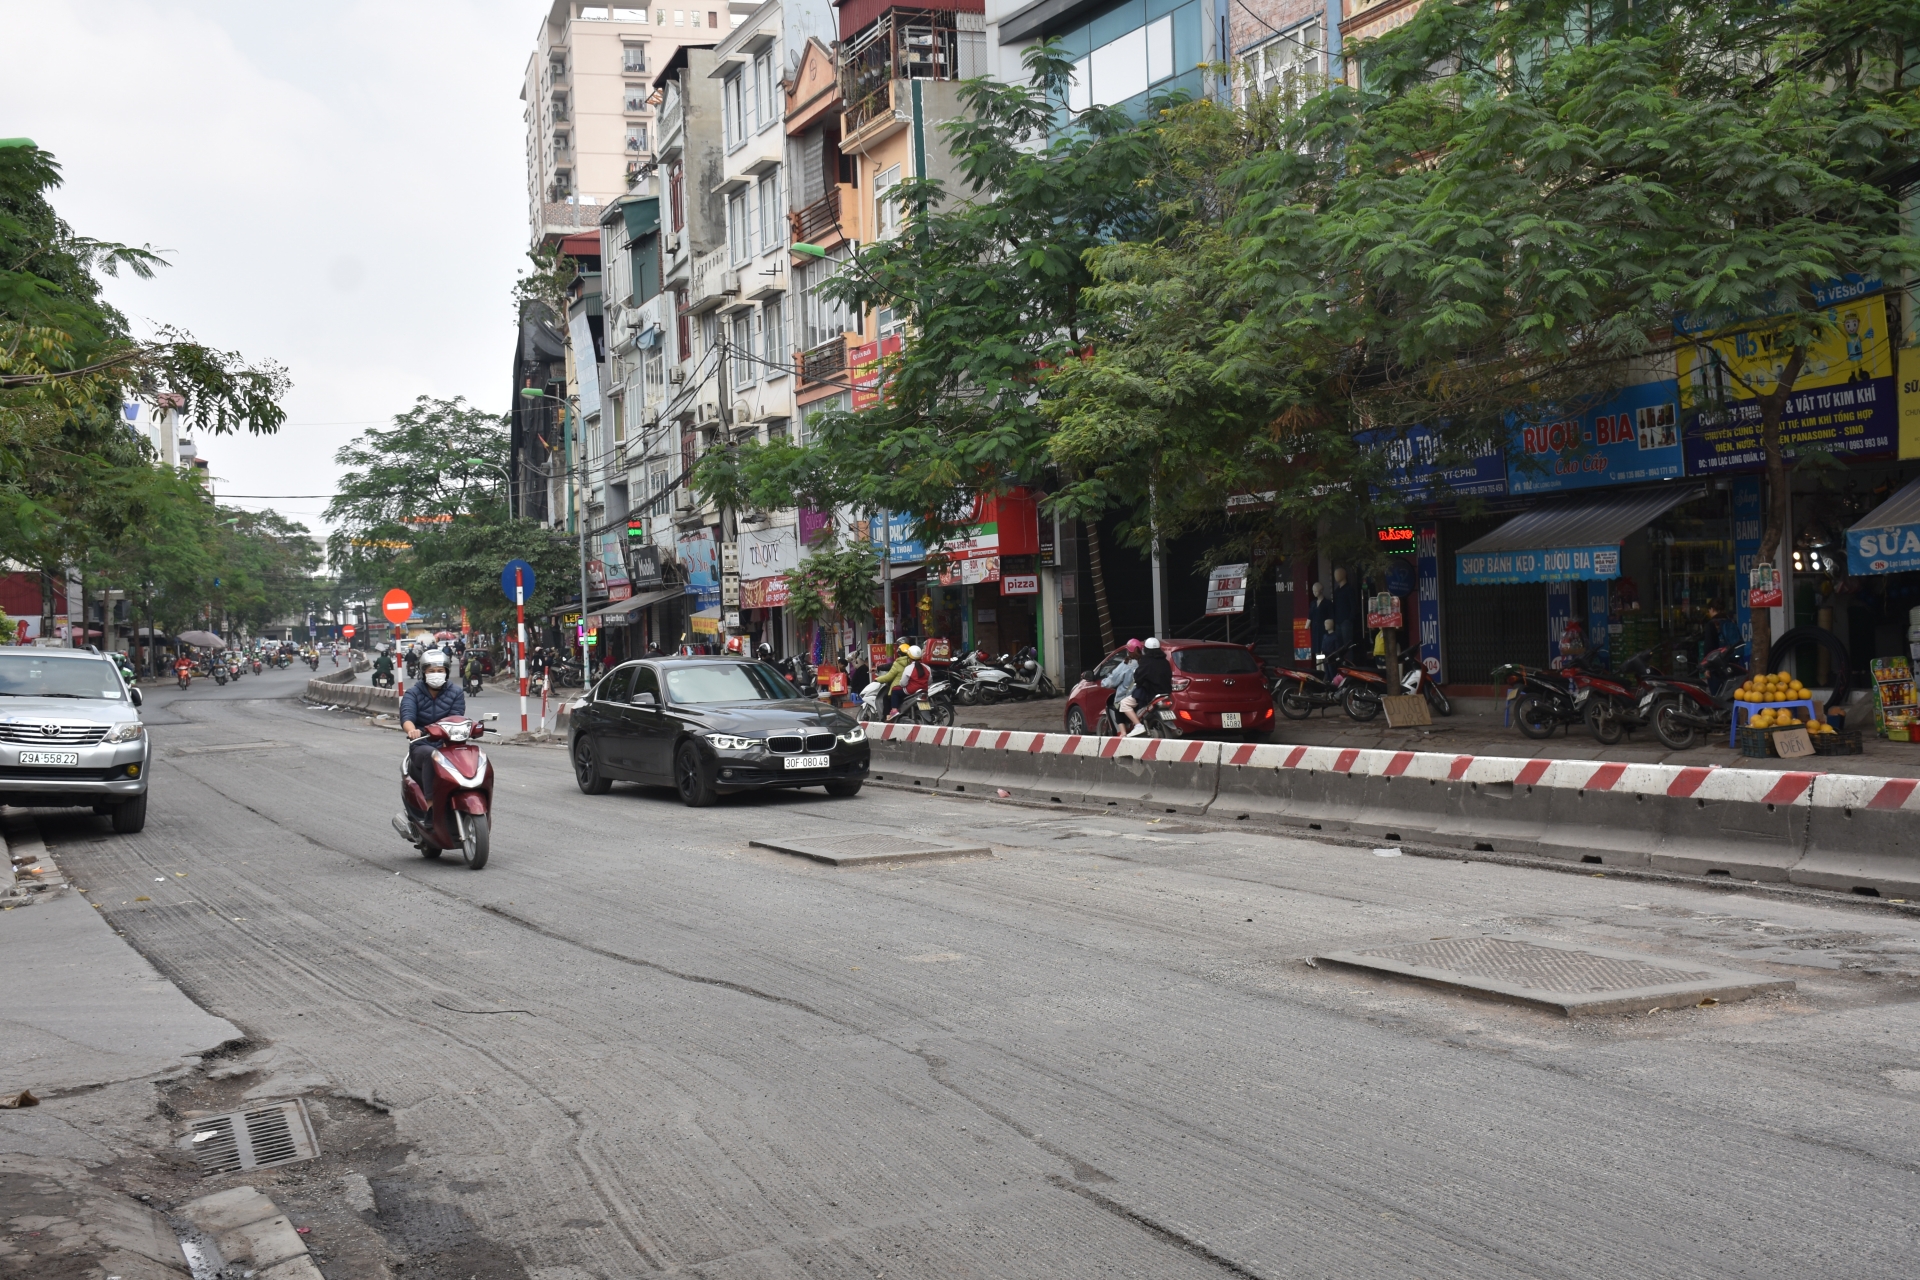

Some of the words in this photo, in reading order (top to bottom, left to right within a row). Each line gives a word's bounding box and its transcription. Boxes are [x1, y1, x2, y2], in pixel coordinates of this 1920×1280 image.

[1828, 282, 1865, 300] VESBO
[1904, 380, 1920, 394] SỮ
[1796, 395, 1815, 415] VẬT
[1816, 391, 1832, 410] TƯ
[1833, 390, 1854, 407] KIM
[1856, 384, 1877, 403] KHÍ
[1523, 420, 1579, 456] RƯỢU
[1596, 413, 1635, 446] BIA
[1704, 428, 1732, 441] CHUYÊN
[1734, 426, 1754, 437] CUNG
[1787, 419, 1799, 431] TƯ:
[1802, 416, 1816, 428] KIM
[1819, 412, 1832, 425] KHÍ
[1834, 410, 1855, 423] TỔNG
[1857, 409, 1874, 421] HỢP
[1792, 428, 1837, 442] PANASONIC
[1844, 425, 1864, 436] SINO
[1554, 458, 1578, 476] Cao
[1582, 451, 1608, 473] Cấp
[1708, 458, 1717, 467] 100
[1718, 456, 1728, 467] LẠC
[1728, 455, 1742, 465] LONG
[1849, 439, 1864, 450] 0963
[1523, 481, 1532, 490] 102
[1734, 489, 1758, 508] Shop
[1379, 528, 1413, 541] RĂNG
[1736, 517, 1759, 540] BÁNH
[897, 545, 912, 555] THOẠI
[1417, 530, 1436, 558] RĂNG
[1859, 527, 1920, 558] SỮA
[1462, 557, 1485, 574] SHOP
[1488, 553, 1512, 573] BÁNH
[1516, 555, 1535, 575] KẸO
[1544, 551, 1570, 573] RƯỢU
[1574, 552, 1590, 569] BIA
[1008, 579, 1034, 591] pizza
[1420, 571, 1437, 601] HÀM
[1591, 596, 1605, 614] CAO
[1422, 614, 1437, 649] MẶT
[1592, 621, 1606, 644] CẤP
[1425, 661, 1438, 670] 104
